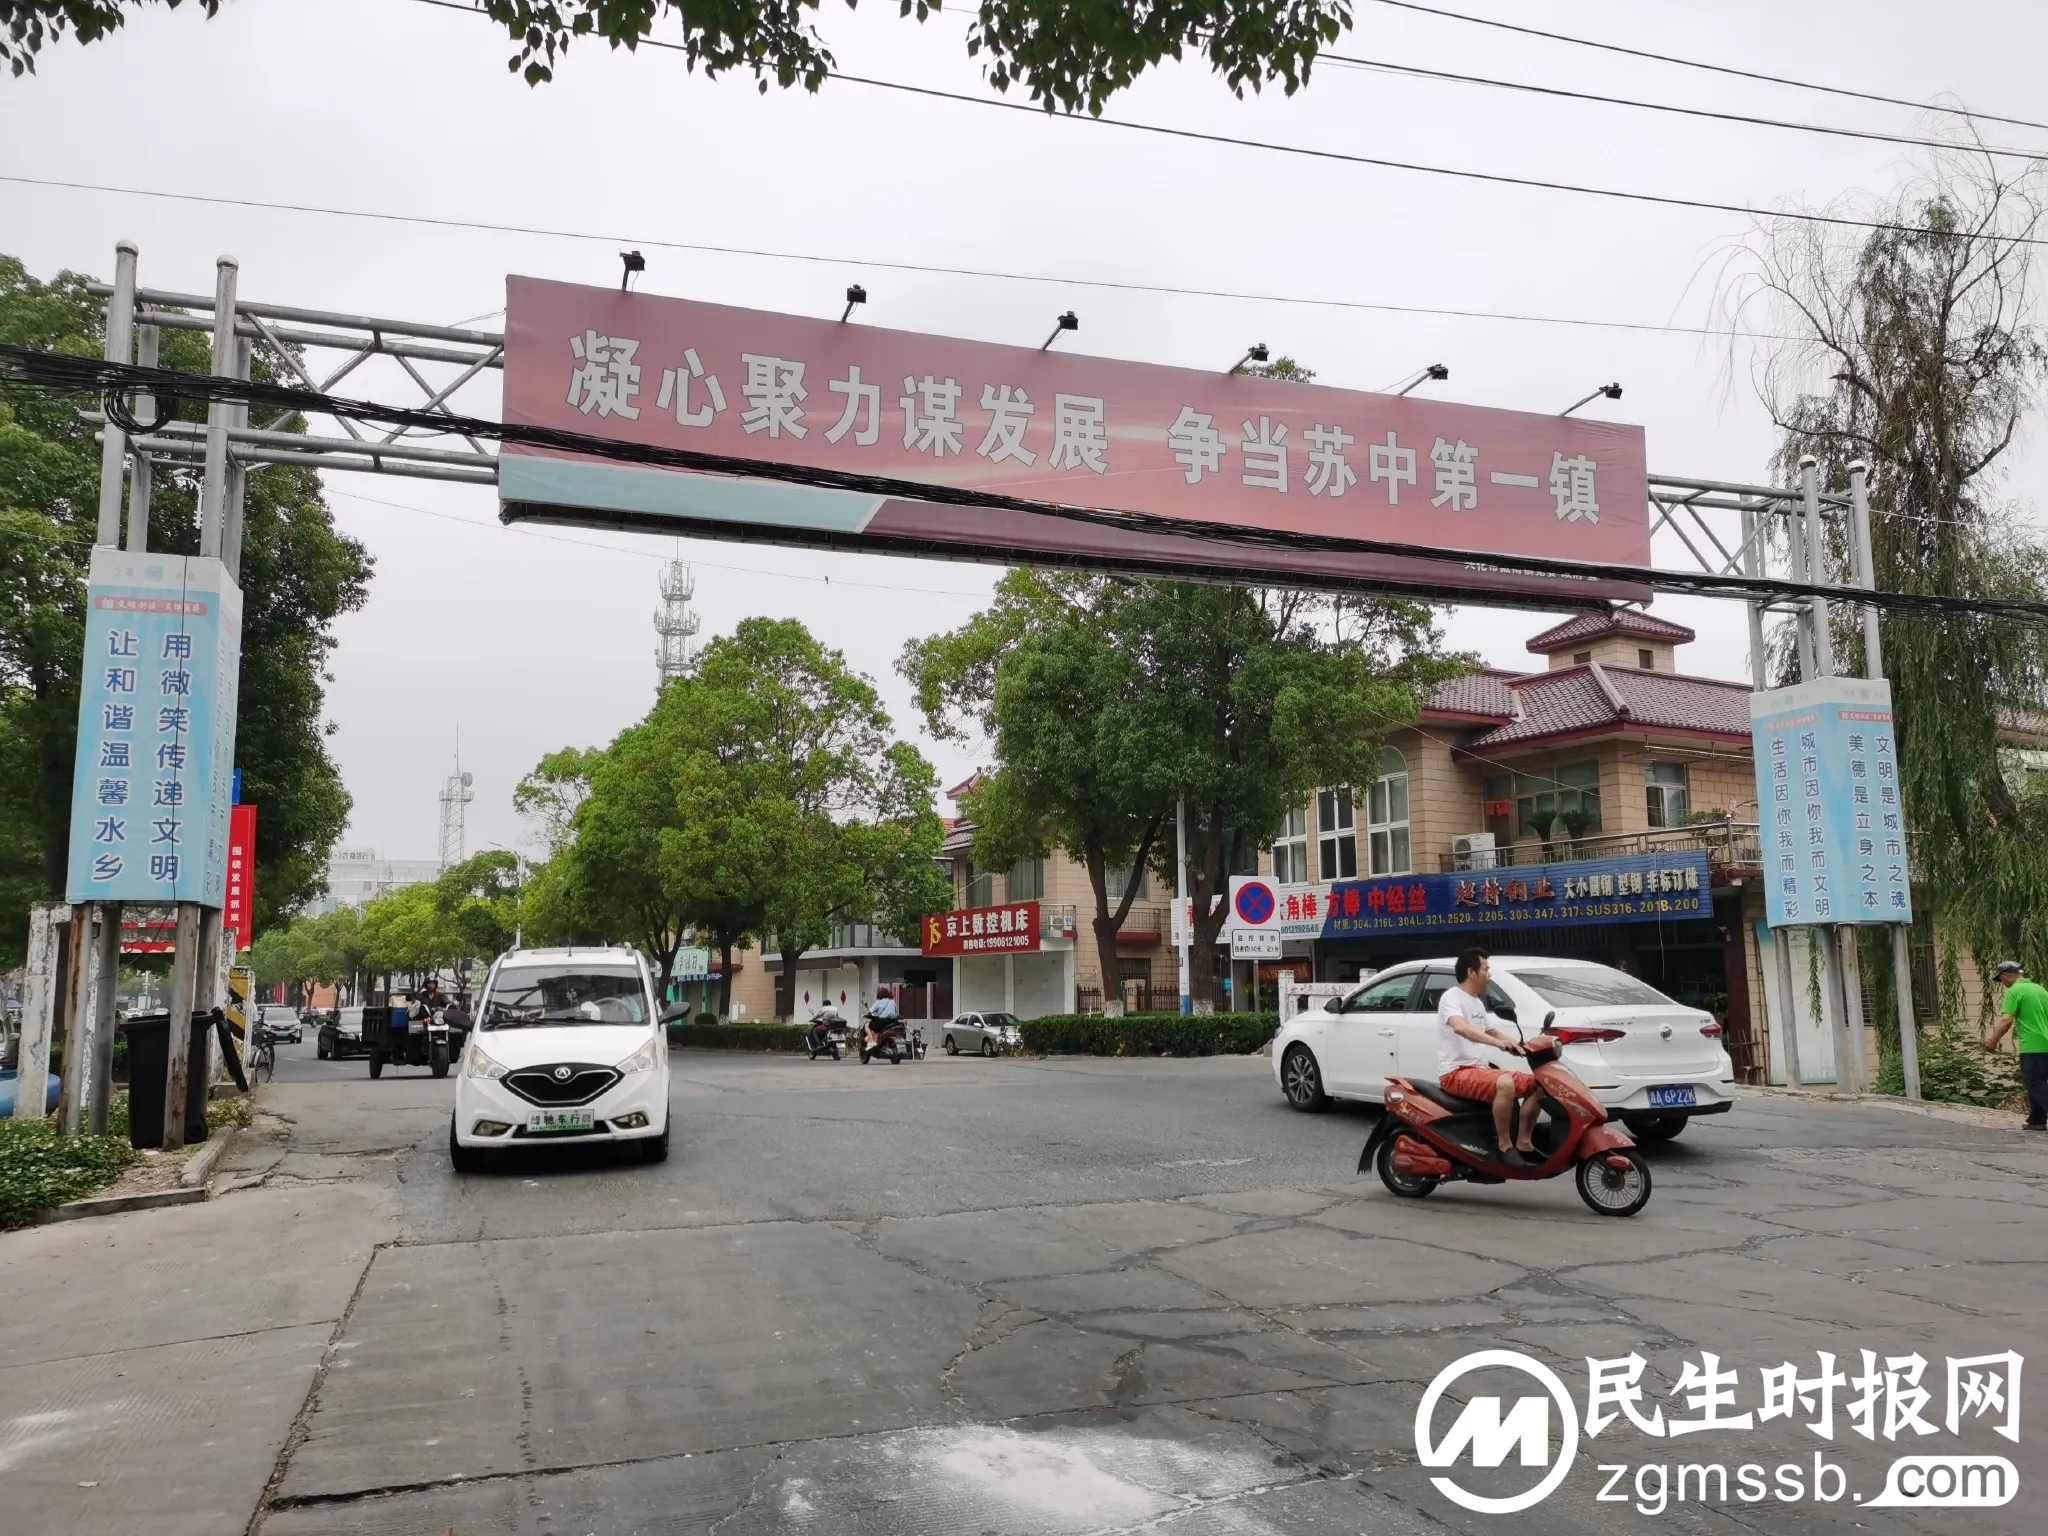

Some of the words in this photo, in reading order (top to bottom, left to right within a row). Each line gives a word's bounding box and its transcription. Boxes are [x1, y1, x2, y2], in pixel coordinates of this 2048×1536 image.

[566, 329, 1109, 475] 凝心聚力谋发展
[1167, 405, 1601, 526] 争当苏中第一镇
[91, 630, 139, 882] 让和谐温馨水乡
[151, 633, 192, 882] 用微笑传递文明
[1770, 738, 1800, 919] 生活因你我而精彩
[1800, 731, 1830, 917] 城市因你我而文明
[1848, 735, 1879, 908] 美德是立身之本
[1875, 735, 1906, 909] 文明是城市之魂
[946, 908, 1029, 938] 京上数控机床
[1368, 883, 1427, 915] 中经丝
